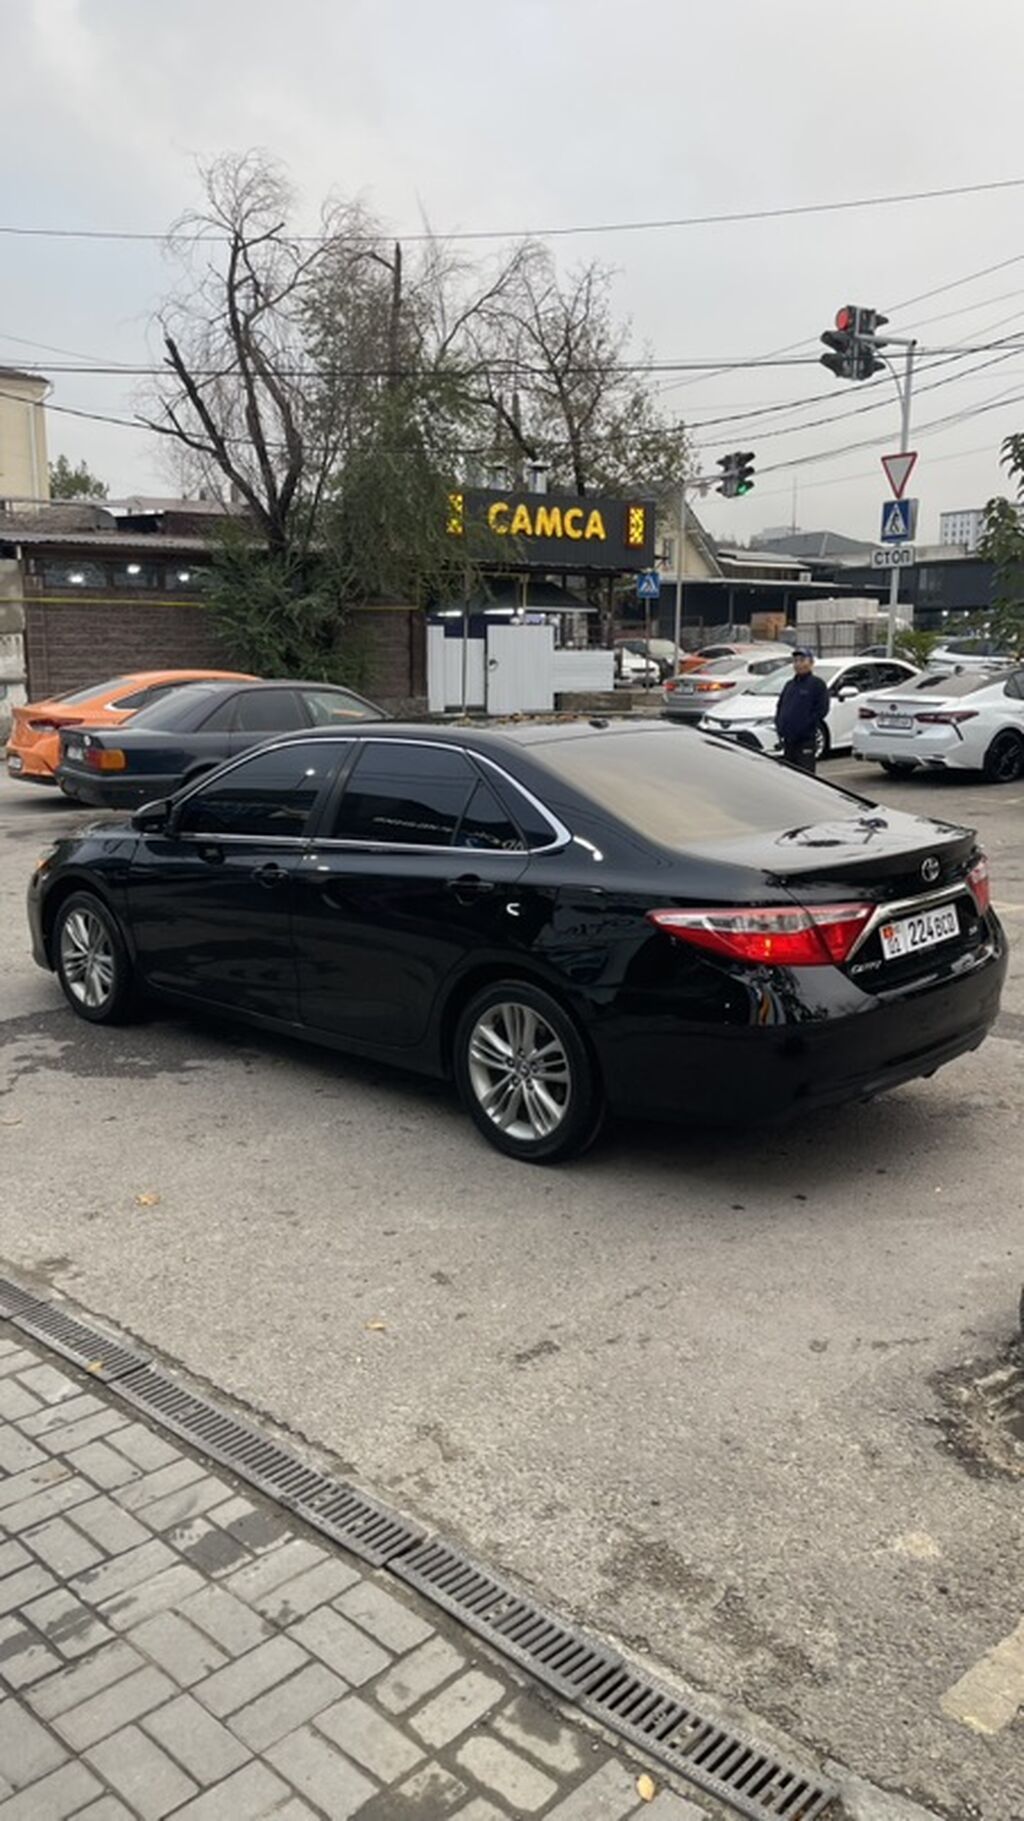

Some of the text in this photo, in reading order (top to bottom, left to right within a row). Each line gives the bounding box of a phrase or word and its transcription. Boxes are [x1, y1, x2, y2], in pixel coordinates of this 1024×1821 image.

[488, 502, 606, 540] САМСА
[874, 550, 911, 566] СТОП
[908, 917, 934, 946] 224
